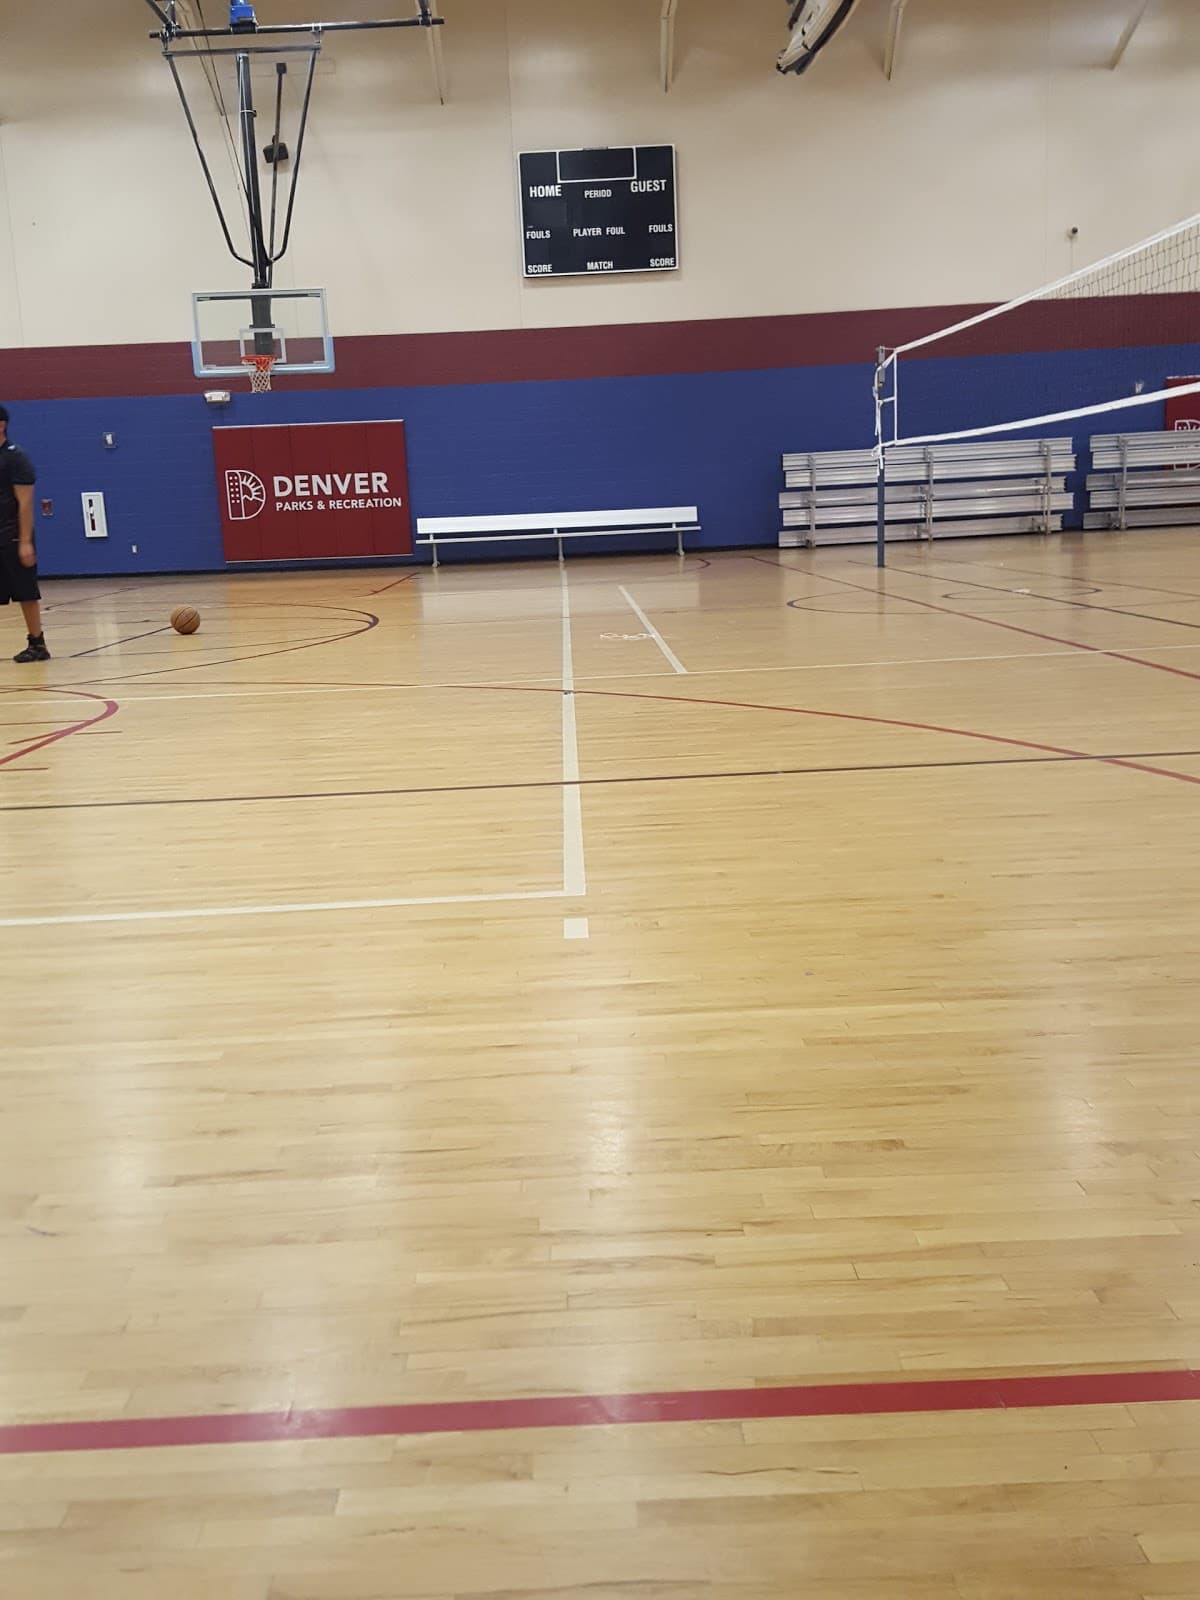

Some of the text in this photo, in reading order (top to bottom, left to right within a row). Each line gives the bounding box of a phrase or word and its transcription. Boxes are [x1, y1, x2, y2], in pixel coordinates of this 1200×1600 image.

[630, 179, 667, 192] GUEST
[530, 185, 562, 198] HOME
[584, 189, 612, 198] PERIOD
[573, 226, 625, 237] PLAYER FOUL
[649, 224, 673, 233] FOULS
[526, 230, 551, 239] FOULS
[587, 261, 613, 270] MATCH
[650, 257, 675, 267] SCORE
[527, 264, 552, 273] SCORE
[273, 472, 389, 497] DENVER
[276, 498, 402, 511] PARKS & RECREATION
